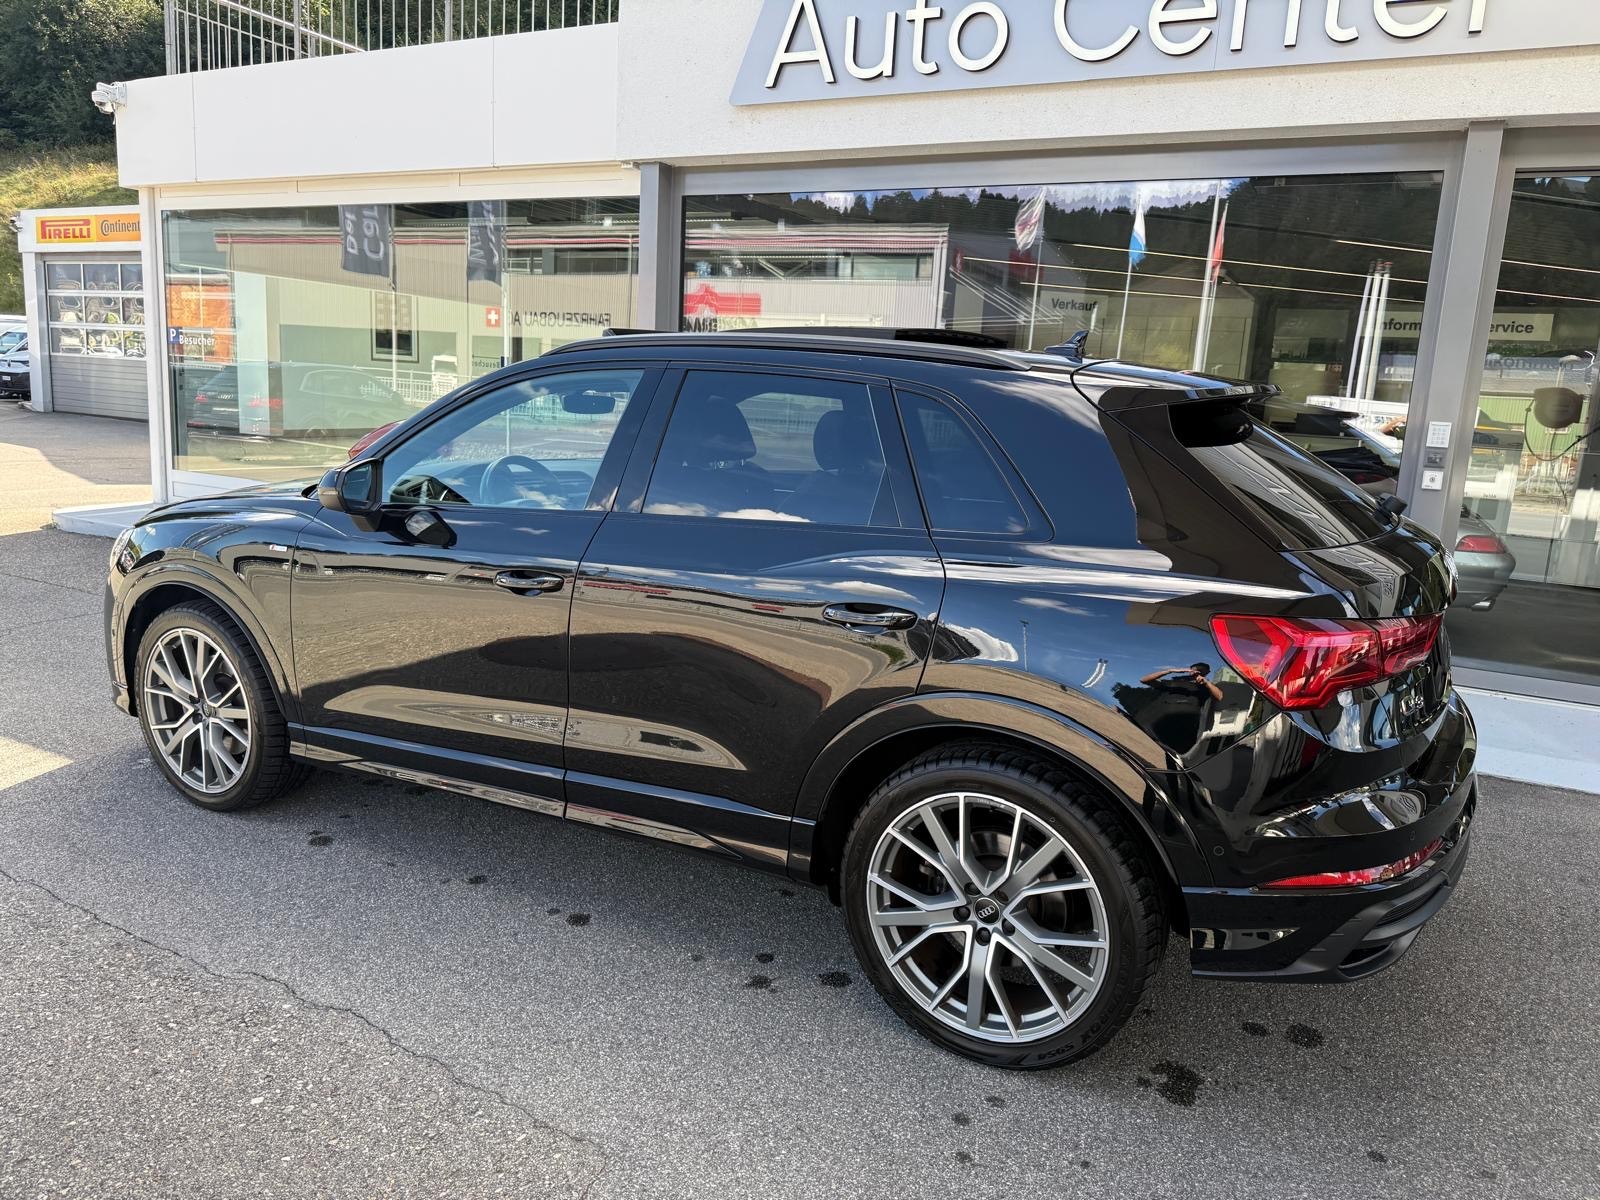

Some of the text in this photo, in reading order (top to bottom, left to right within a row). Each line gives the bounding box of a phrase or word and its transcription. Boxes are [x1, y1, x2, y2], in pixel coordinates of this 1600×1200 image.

[764, 0, 1009, 88] Auto
[41, 219, 91, 239] PIRELLI
[1052, 298, 1098, 312] Verkauf
[1489, 321, 1534, 333] ervice
[179, 334, 216, 346] Besucher
